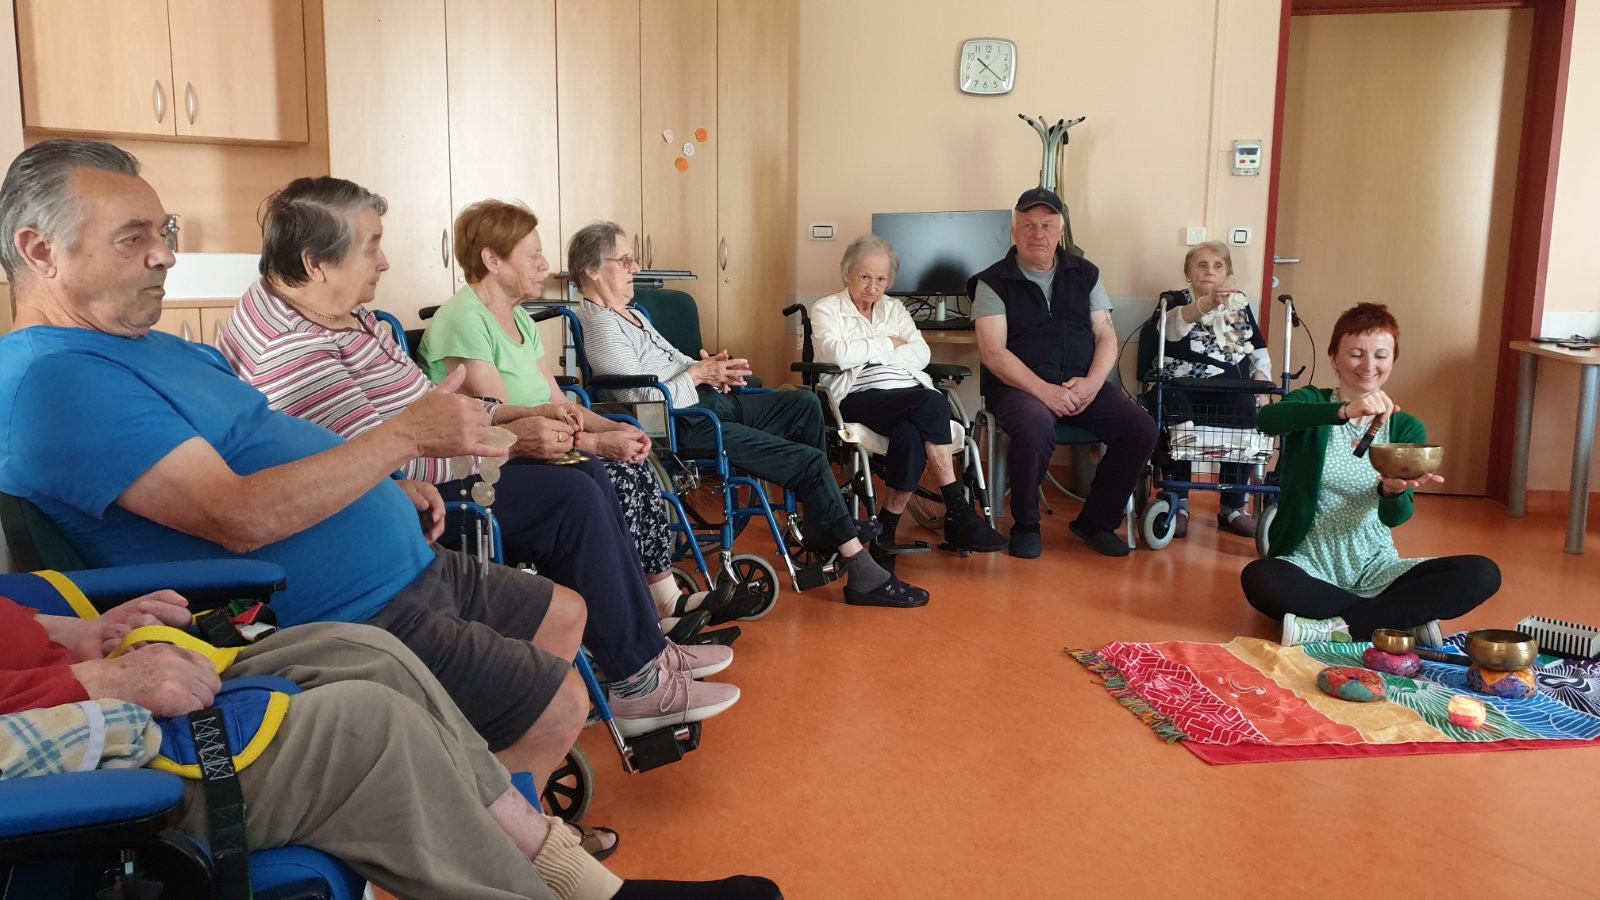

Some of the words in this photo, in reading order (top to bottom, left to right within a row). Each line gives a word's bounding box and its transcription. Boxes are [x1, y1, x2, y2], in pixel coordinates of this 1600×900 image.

[975, 45, 981, 54] 11
[985, 45, 992, 53] 12
[967, 52, 975, 60] 10
[1004, 53, 1008, 61] 2
[1004, 63, 1008, 72] 3
[974, 80, 979, 88] 7
[993, 80, 998, 88] 5
